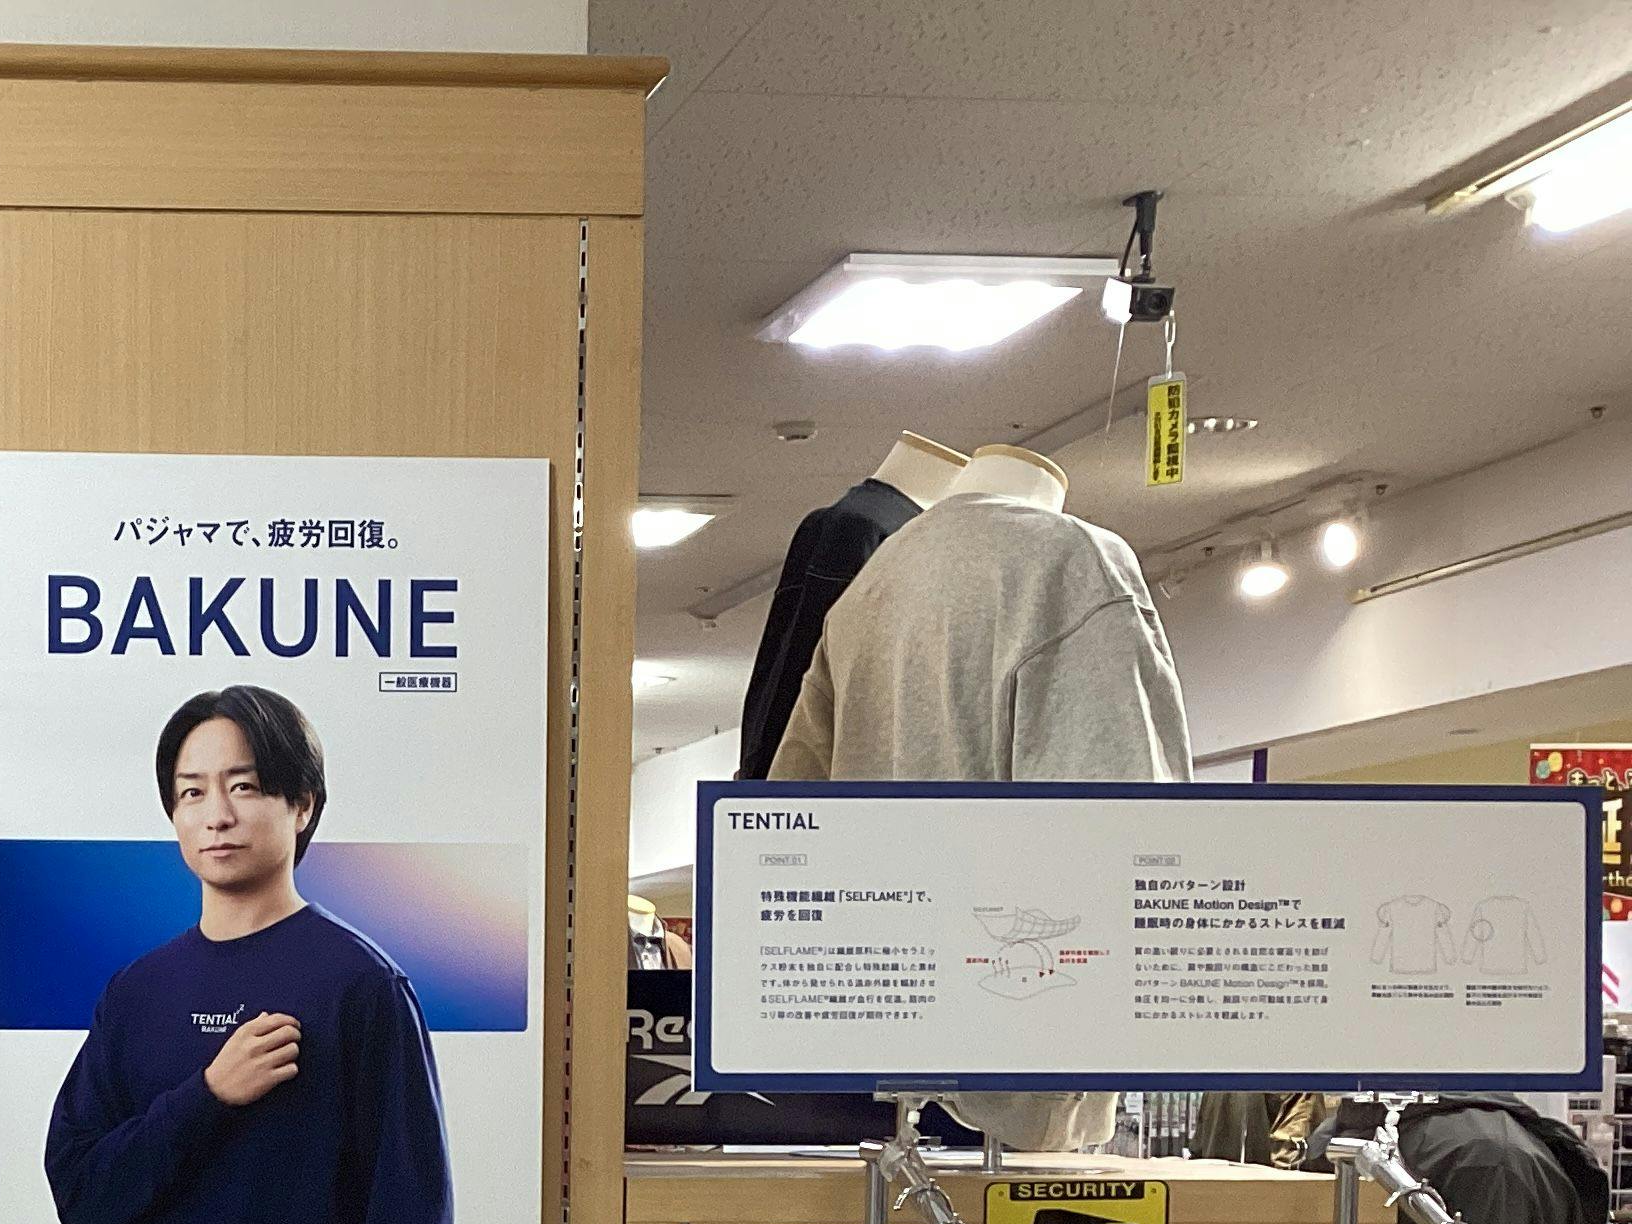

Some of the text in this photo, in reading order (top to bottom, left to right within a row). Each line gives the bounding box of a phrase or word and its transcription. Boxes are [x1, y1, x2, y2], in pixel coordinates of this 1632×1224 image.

[113, 516, 399, 550] パジャマで、疲労回復。
[46, 573, 459, 659] BAKUNE
[384, 676, 453, 690] 一般医療機器
[728, 812, 820, 830] TENTIAL
[1134, 879, 1246, 892] 独自のパターン設計
[1134, 899, 1189, 911] BAKUNE
[1193, 899, 1234, 911] Motion
[760, 909, 823, 922] 疲労を回復
[191, 1012, 238, 1025] TENTIAL
[626, 1009, 691, 1050] Re
[1017, 1182, 1137, 1199] SECURITY
